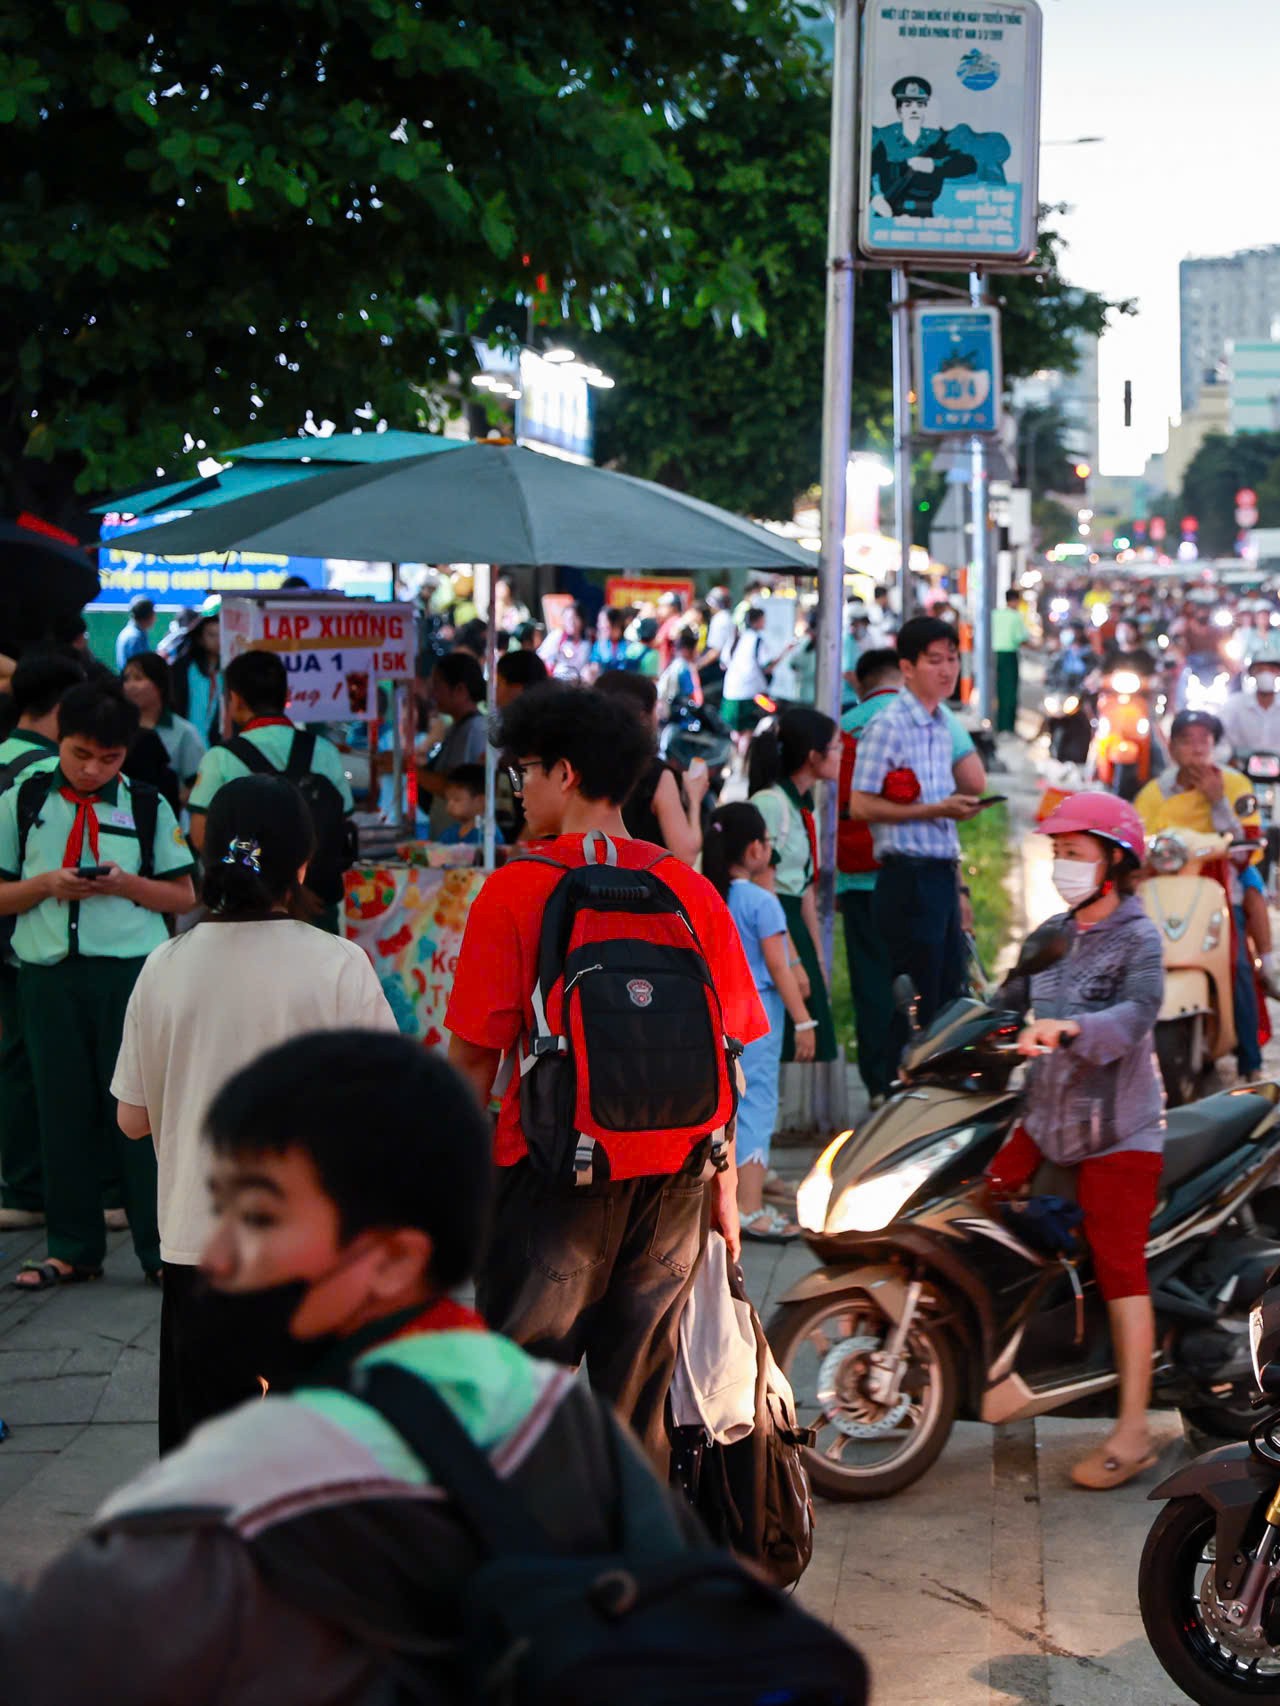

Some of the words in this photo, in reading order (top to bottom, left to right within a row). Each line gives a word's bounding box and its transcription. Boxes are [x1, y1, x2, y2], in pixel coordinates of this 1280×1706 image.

[281, 653, 321, 673] UA
[331, 653, 343, 671] 1
[373, 652, 407, 672] 15K
